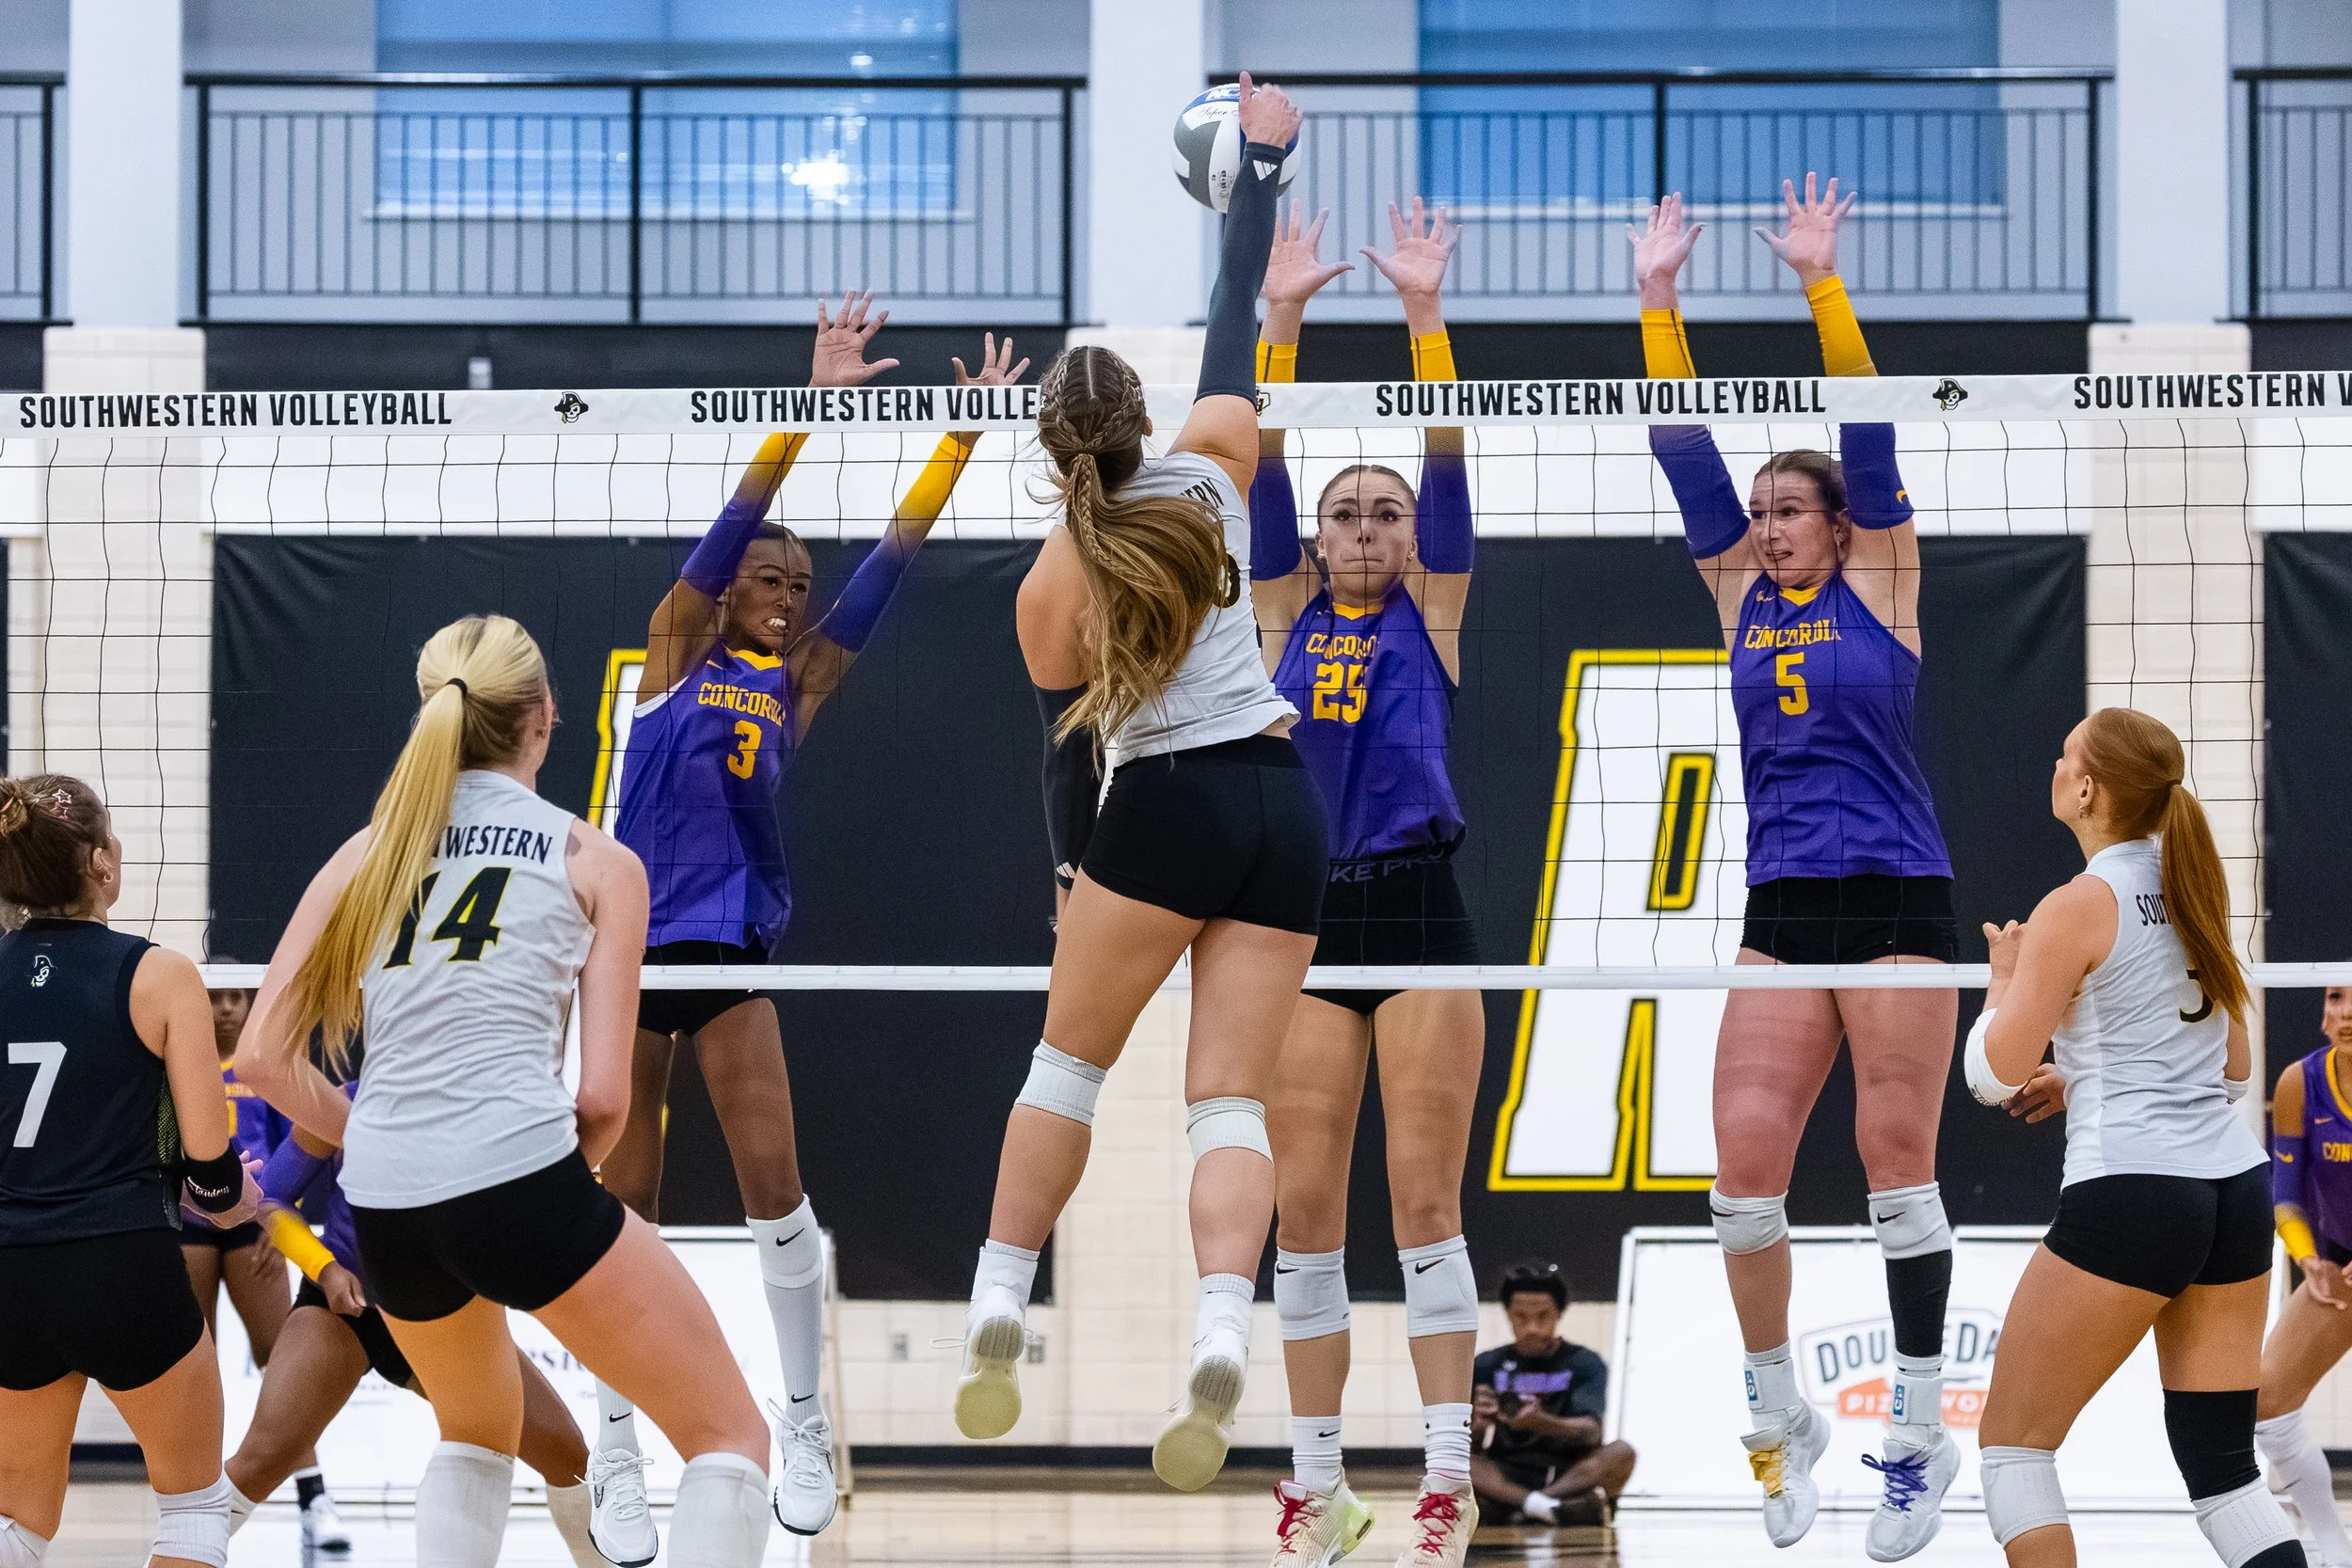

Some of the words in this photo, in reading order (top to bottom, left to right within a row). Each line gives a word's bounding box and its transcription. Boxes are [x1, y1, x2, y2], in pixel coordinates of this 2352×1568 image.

[20, 394, 257, 428] SOUTHWESTERN
[270, 393, 452, 425] VOLLEYBALL
[691, 388, 933, 423] SOUTHWESTERN
[946, 388, 1037, 420] VOLLE
[1375, 382, 1624, 416] SOUTHWESTERN
[1636, 380, 1826, 414] VOLLEYBALL
[2074, 373, 2326, 409] SOUTHWESTERN
[1312, 661, 1367, 723] 25
[1775, 652, 1809, 716] 5
[727, 720, 762, 780] 3
[433, 825, 553, 864] WESTERN
[1329, 862, 1376, 883] KE
[383, 866, 512, 970] 14
[8, 1041, 68, 1148] 7
